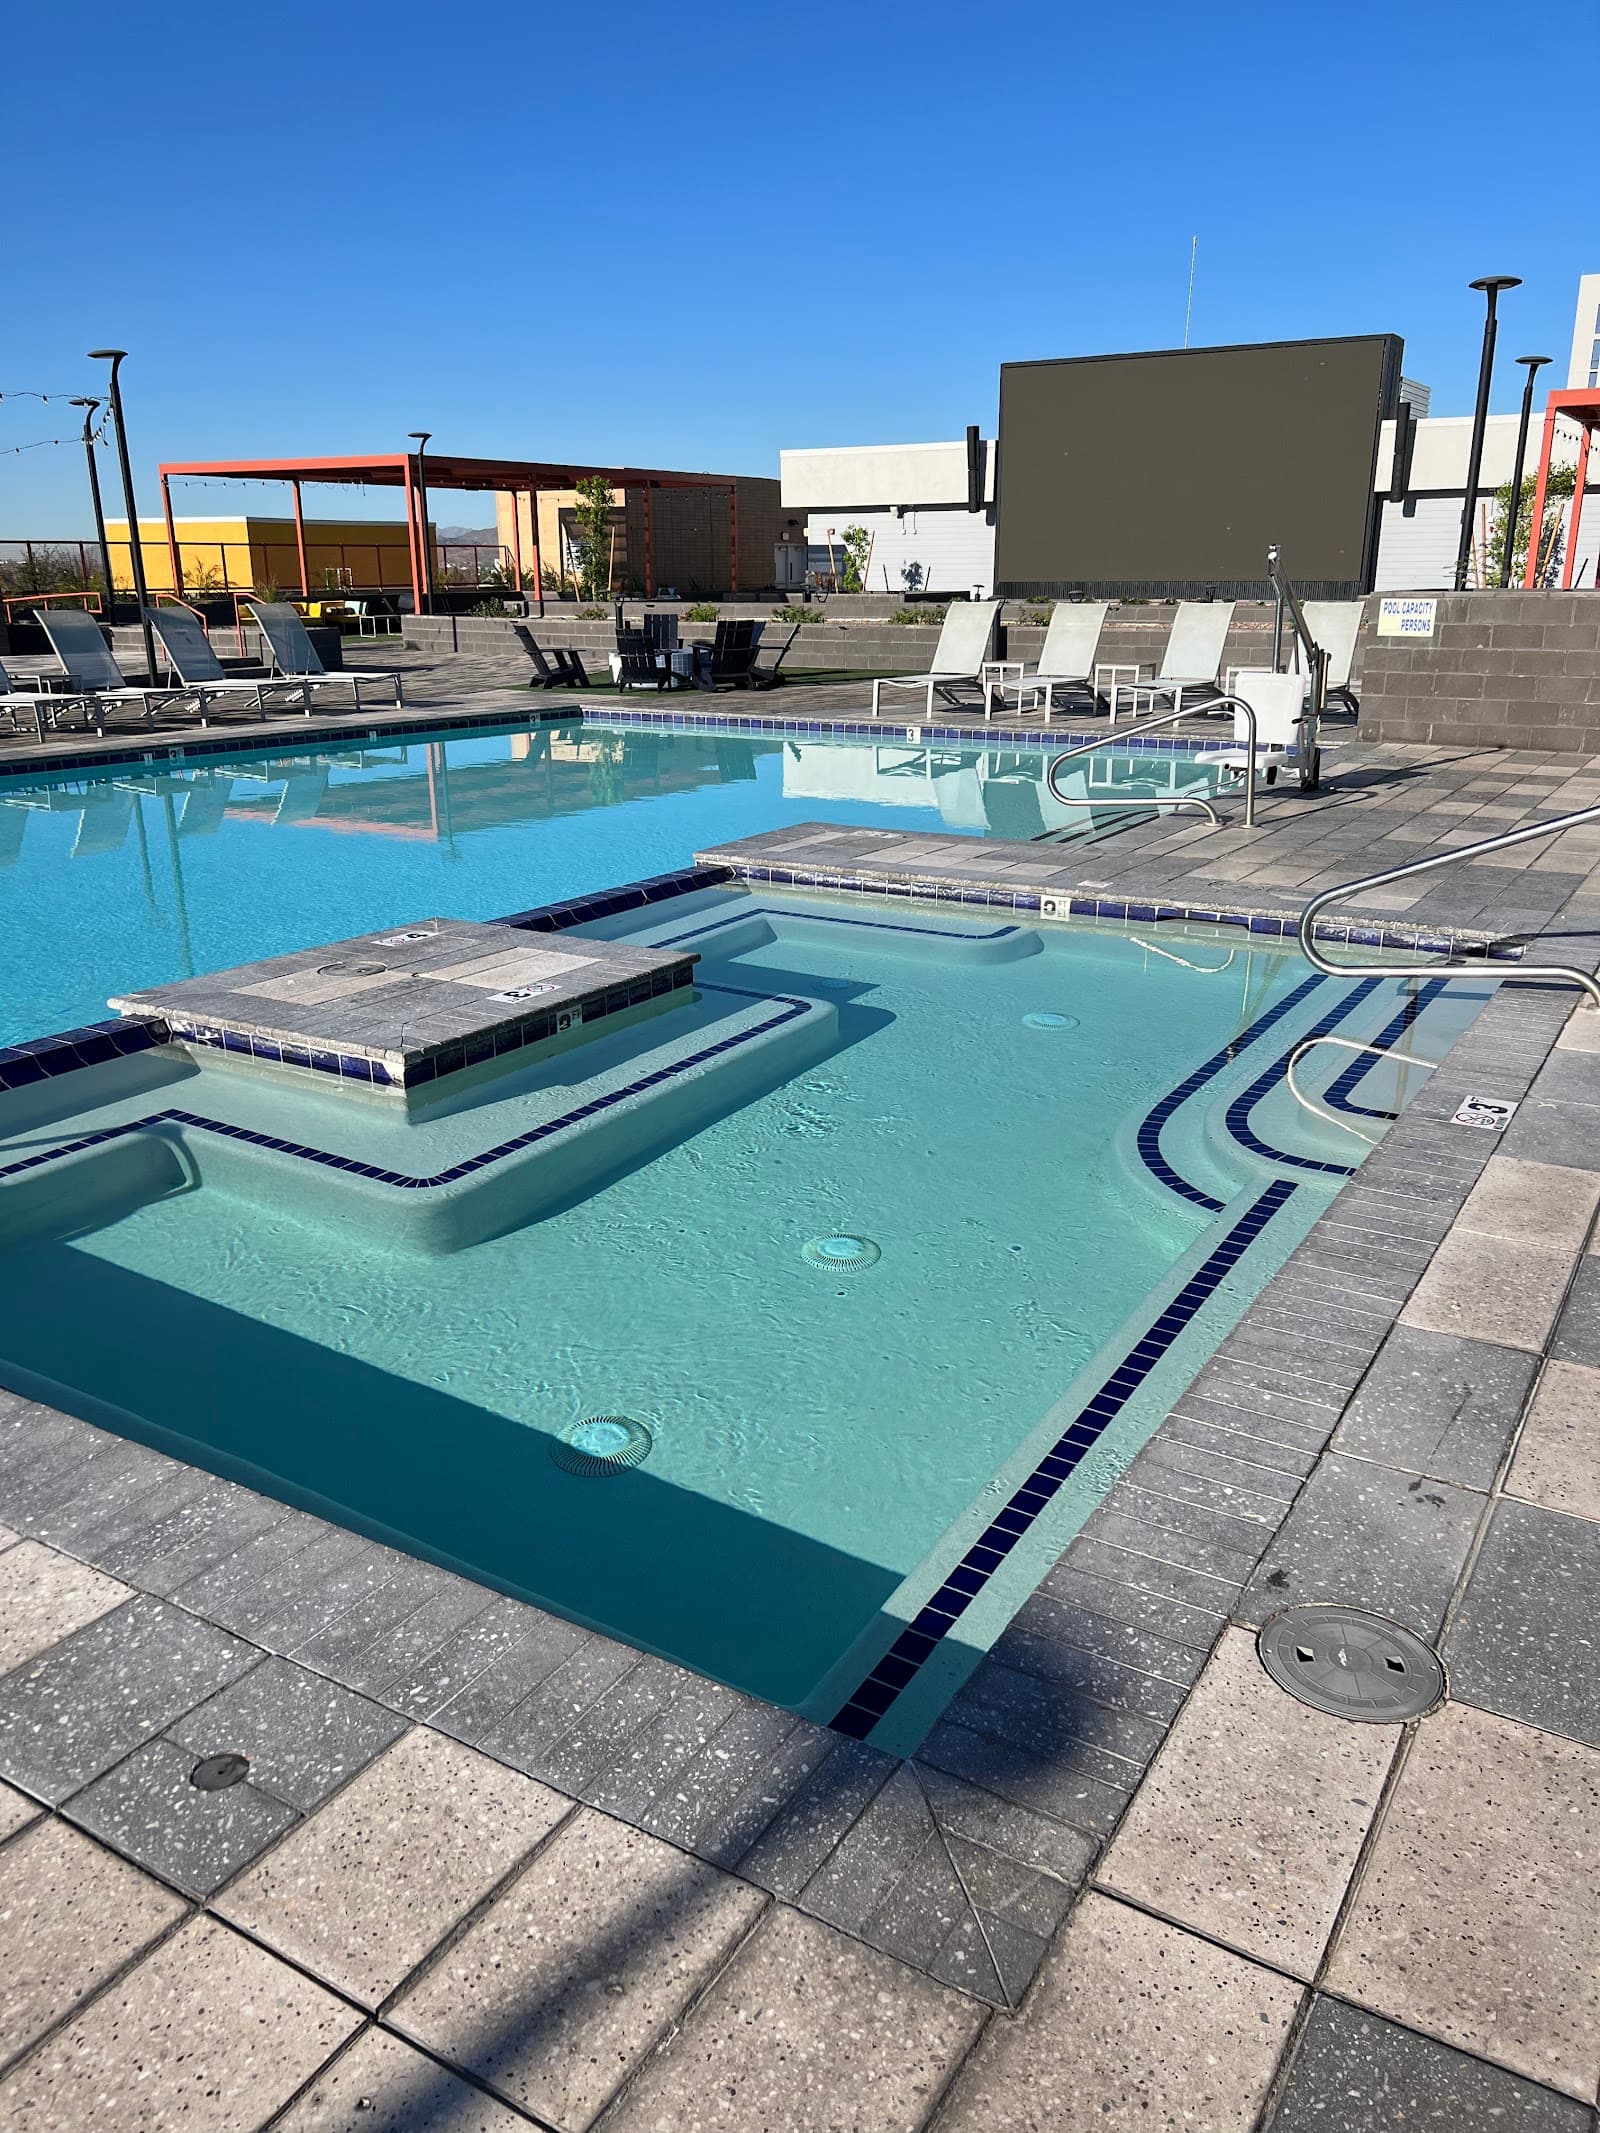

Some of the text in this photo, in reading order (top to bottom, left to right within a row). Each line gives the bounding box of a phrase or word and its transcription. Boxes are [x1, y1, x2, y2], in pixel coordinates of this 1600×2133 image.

[1383, 601, 1433, 614] POOL CAPACITY
[1401, 618, 1431, 631] PERSONS
[908, 728, 914, 742] 3
[1468, 1102, 1508, 1113] 3
